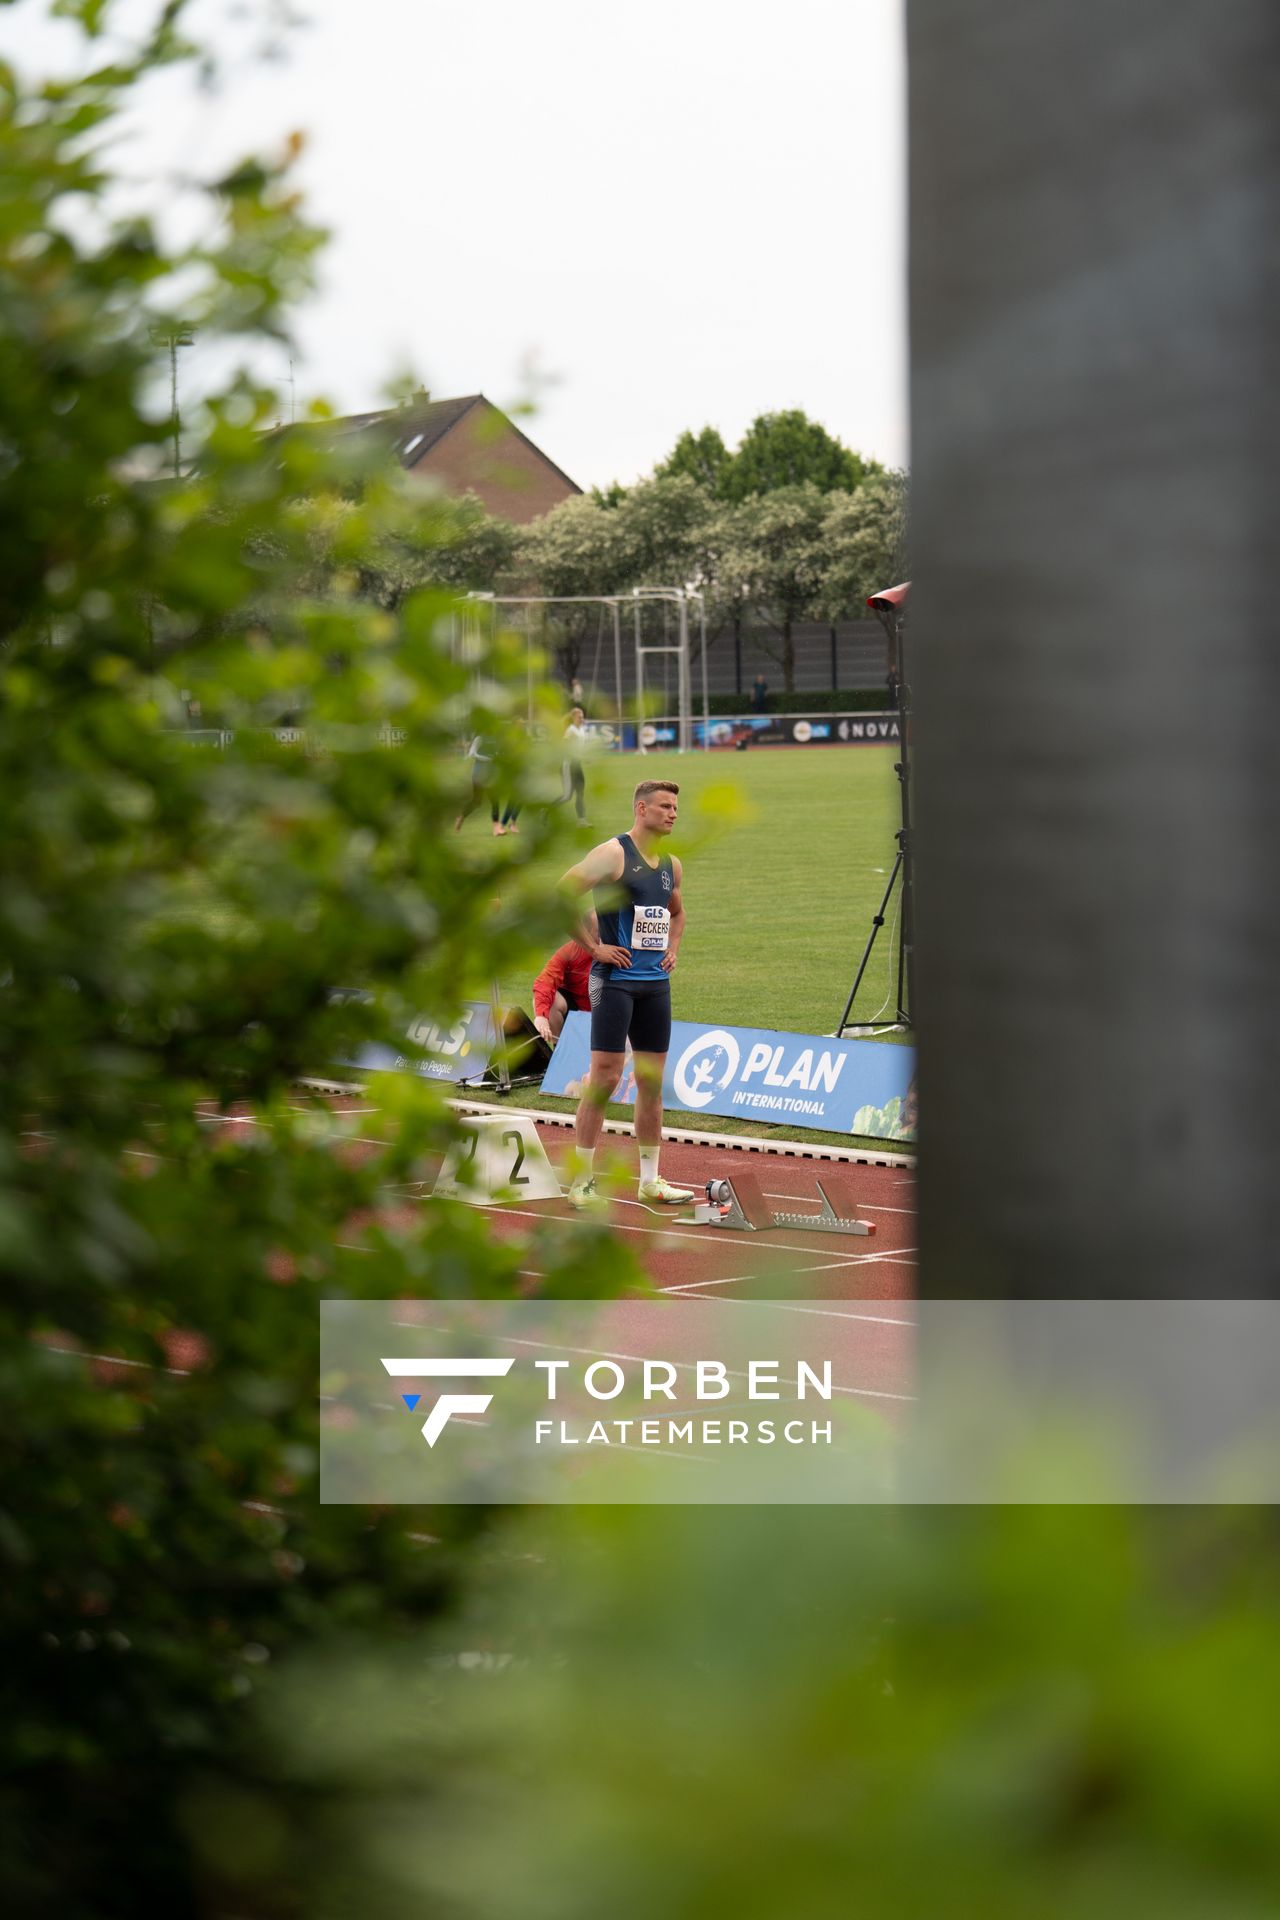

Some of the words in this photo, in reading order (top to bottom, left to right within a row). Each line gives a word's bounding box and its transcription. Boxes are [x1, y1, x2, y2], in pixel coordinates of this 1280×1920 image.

[644, 908, 663, 919] GLS
[635, 921, 669, 934] BECKERS
[420, 1060, 428, 1071] to
[428, 1060, 453, 1076] People
[740, 1043, 847, 1093] PLAN
[732, 1091, 825, 1115] INTERNATIONAL
[503, 1130, 530, 1185] 2
